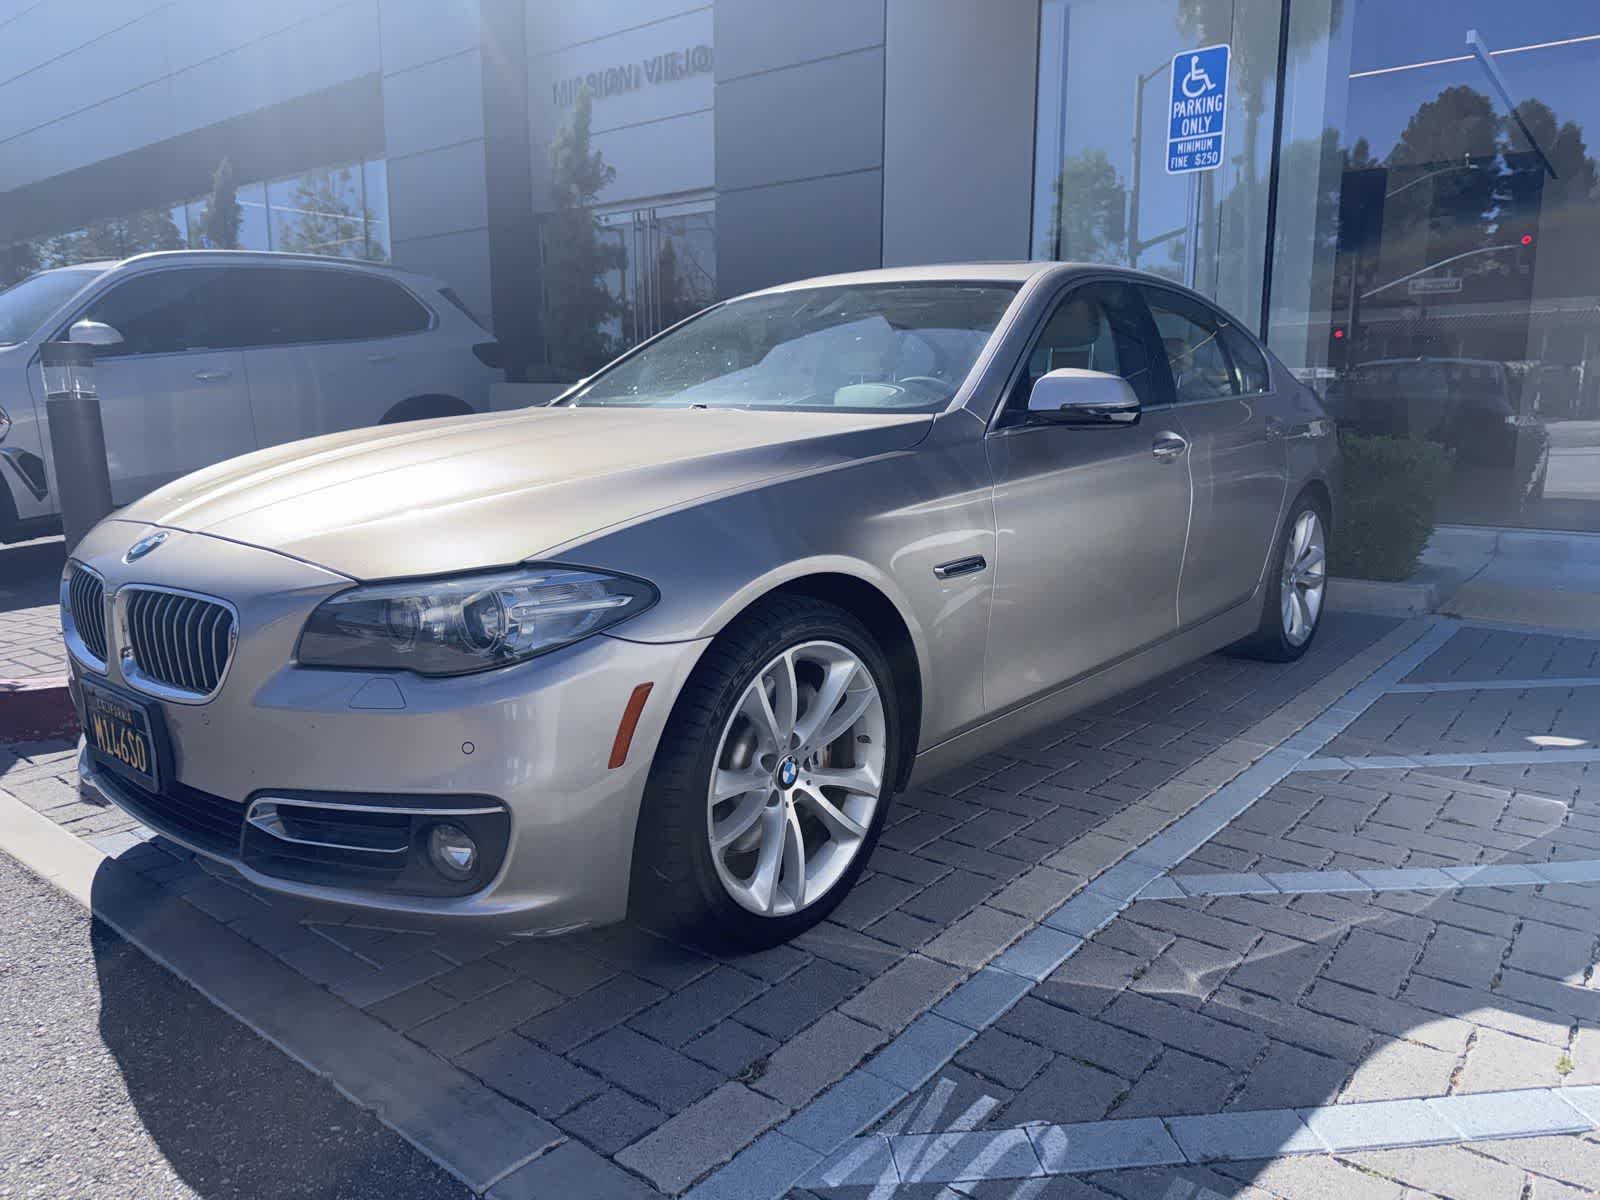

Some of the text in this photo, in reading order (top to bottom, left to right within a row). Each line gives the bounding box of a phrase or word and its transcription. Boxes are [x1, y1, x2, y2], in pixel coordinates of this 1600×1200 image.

[1173, 94, 1223, 119] PARKING
[1181, 115, 1212, 136] ONLY
[1177, 138, 1213, 154] MINIMUM
[1171, 151, 1218, 169] FINE $250
